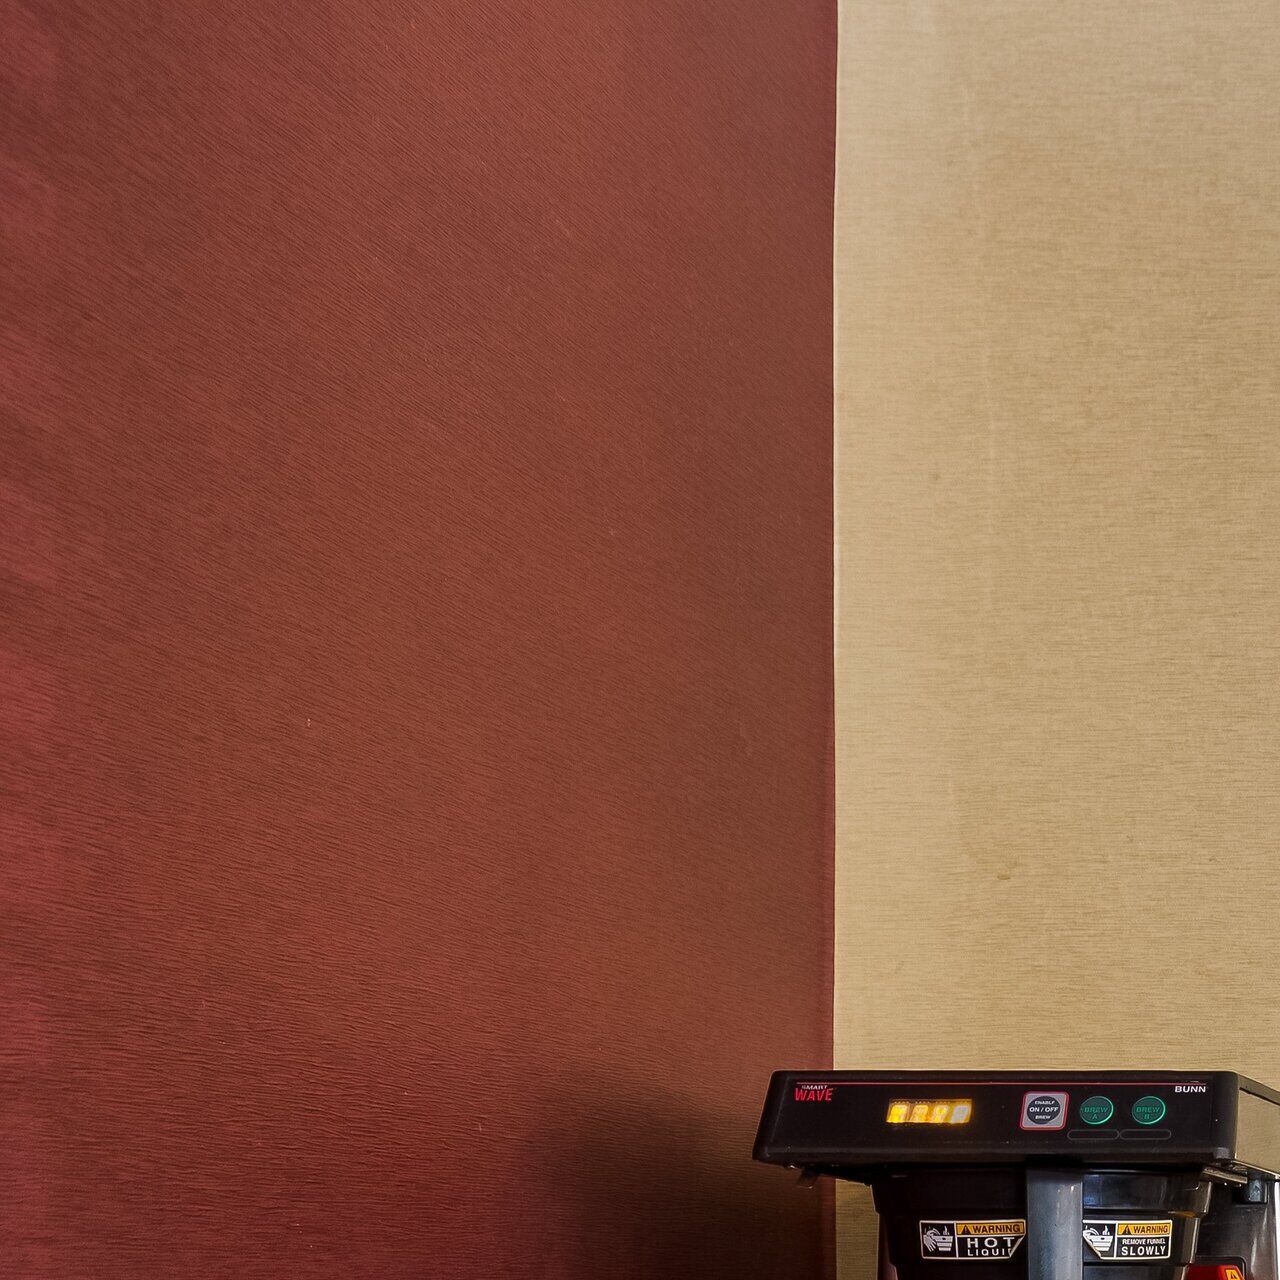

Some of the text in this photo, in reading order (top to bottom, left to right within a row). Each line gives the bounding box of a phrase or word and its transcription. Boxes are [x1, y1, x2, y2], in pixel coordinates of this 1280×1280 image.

[1174, 1085, 1207, 1093] BUNN
[794, 1088, 834, 1101] WAVE
[972, 1224, 1020, 1234] WARNING
[1133, 1225, 1168, 1234] WARNING
[967, 1237, 1015, 1248] HOT
[1121, 1245, 1166, 1256] SLOWLY
